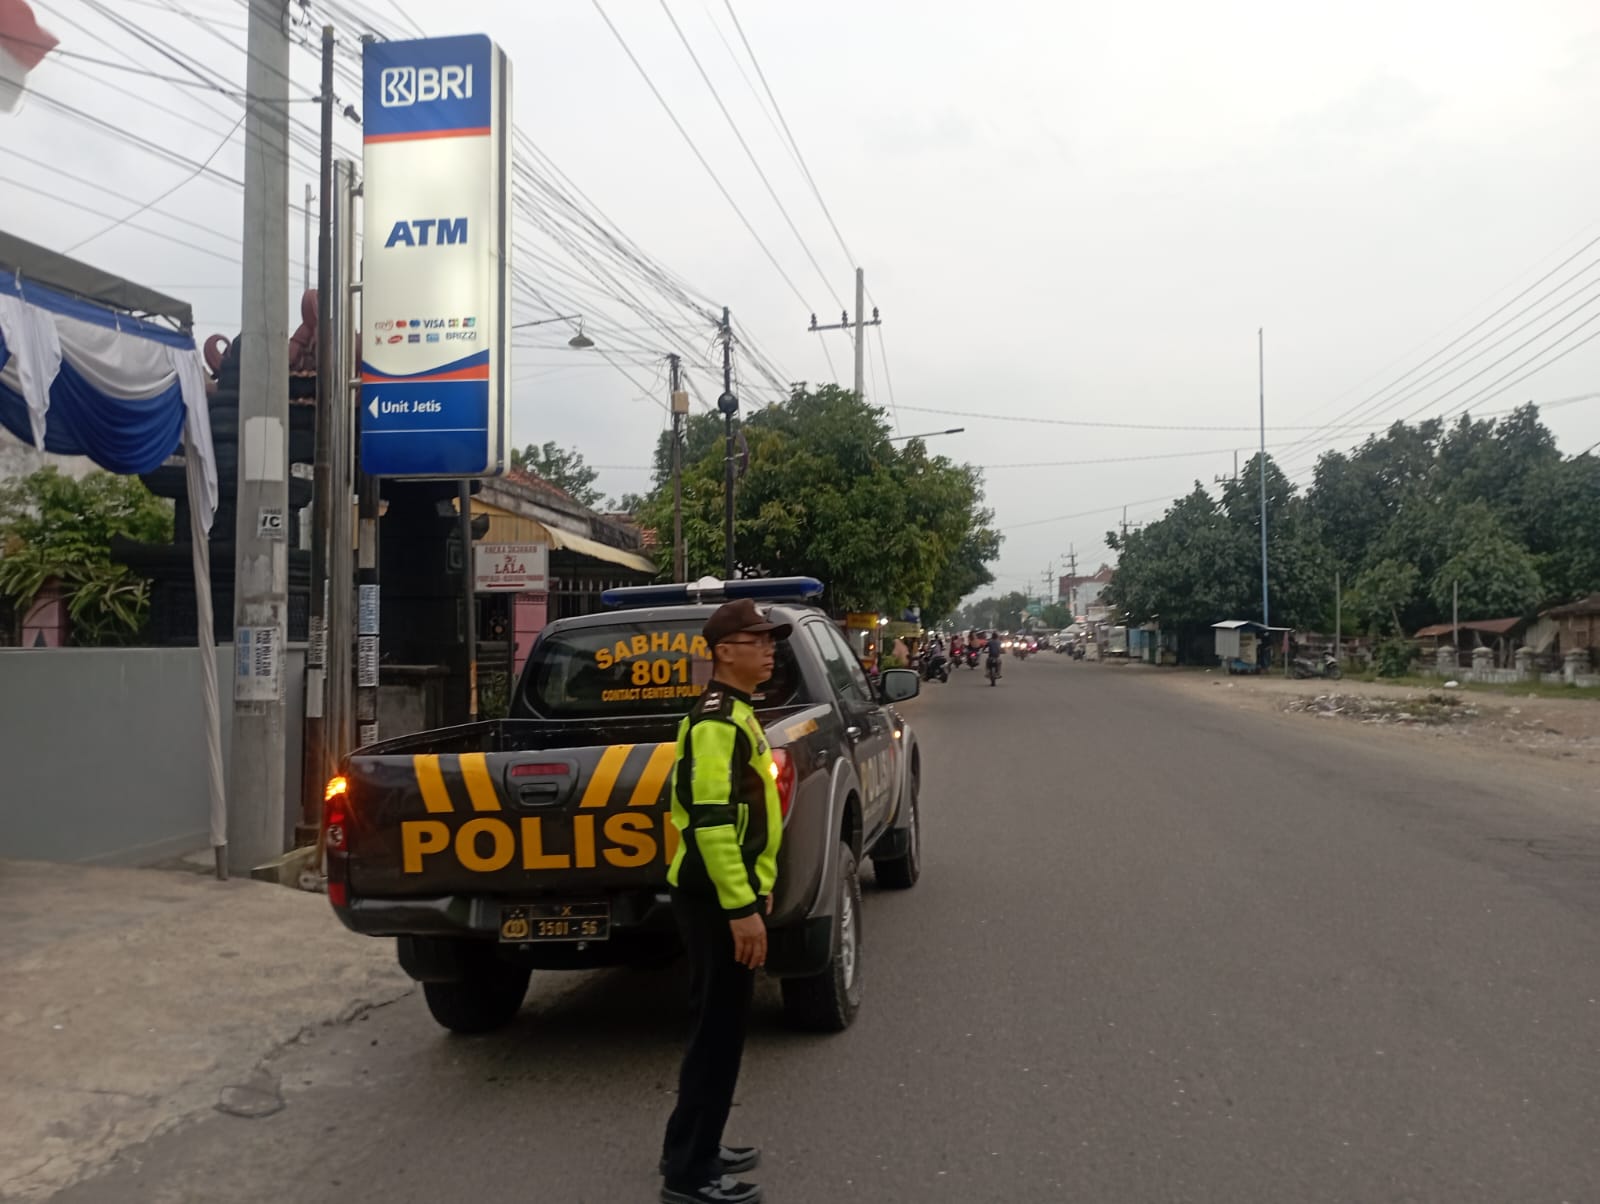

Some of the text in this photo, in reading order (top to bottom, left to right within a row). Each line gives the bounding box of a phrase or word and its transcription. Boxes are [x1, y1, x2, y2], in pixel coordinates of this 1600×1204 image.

[418, 64, 473, 102] BRI
[384, 217, 468, 248] ATM
[423, 319, 445, 328] VISA
[381, 400, 442, 413] Unit Jetis
[495, 563, 526, 574] LALA
[631, 657, 688, 686] 801
[602, 687, 641, 702] CONTACT
[641, 686, 675, 699] CENTER
